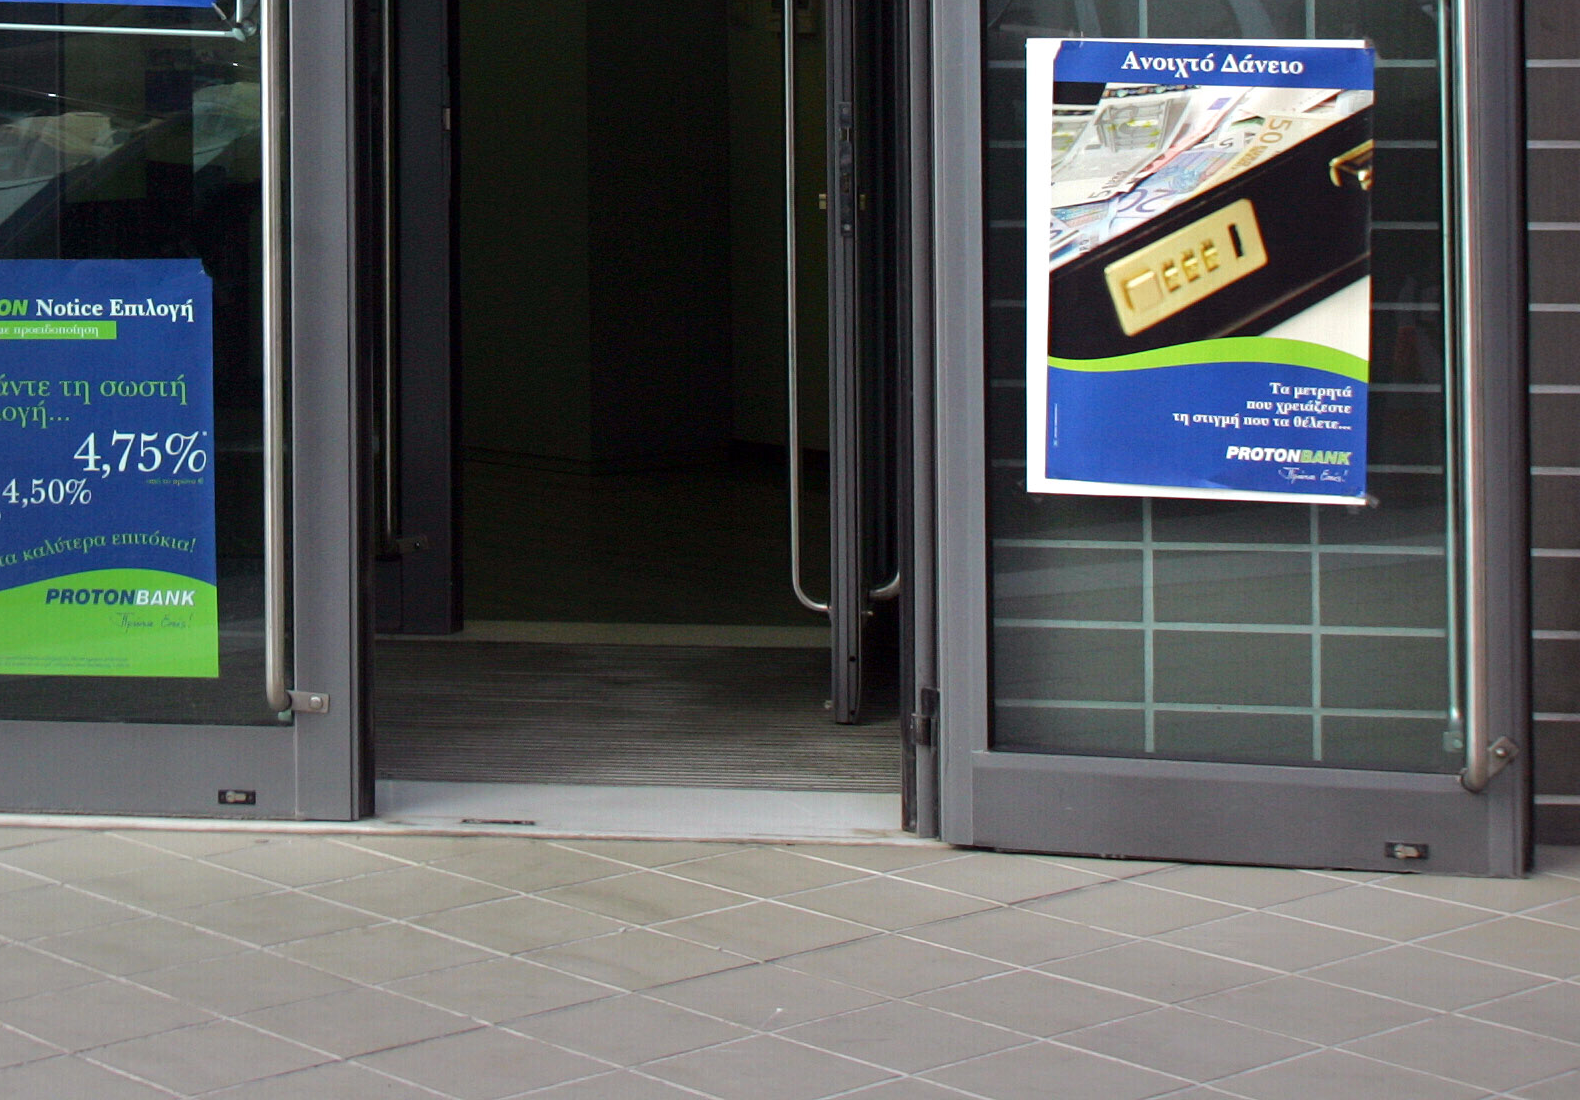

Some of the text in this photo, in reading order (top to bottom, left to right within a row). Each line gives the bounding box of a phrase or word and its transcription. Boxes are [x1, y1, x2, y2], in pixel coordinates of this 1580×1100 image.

[1121, 50, 1304, 79] Ανοιχτό Δάνειο
[36, 298, 103, 317] Notice
[109, 298, 194, 322] Επιλογή
[60, 380, 90, 405] τη
[100, 374, 187, 405] σωστή
[1269, 382, 1352, 401] Τα μετρητά
[1246, 400, 1352, 415] που χρειάζεστε
[1172, 413, 1189, 426] τη
[1193, 413, 1240, 429] στιγμή
[1243, 416, 1270, 426] που
[1273, 418, 1290, 427] τα
[1226, 446, 1352, 465] PROTONBANK
[2, 478, 92, 508] 4,50%
[23, 536, 106, 563] καλύτερα
[111, 531, 197, 554] επιτόκια!
[45, 588, 195, 606] PROTONBANK
